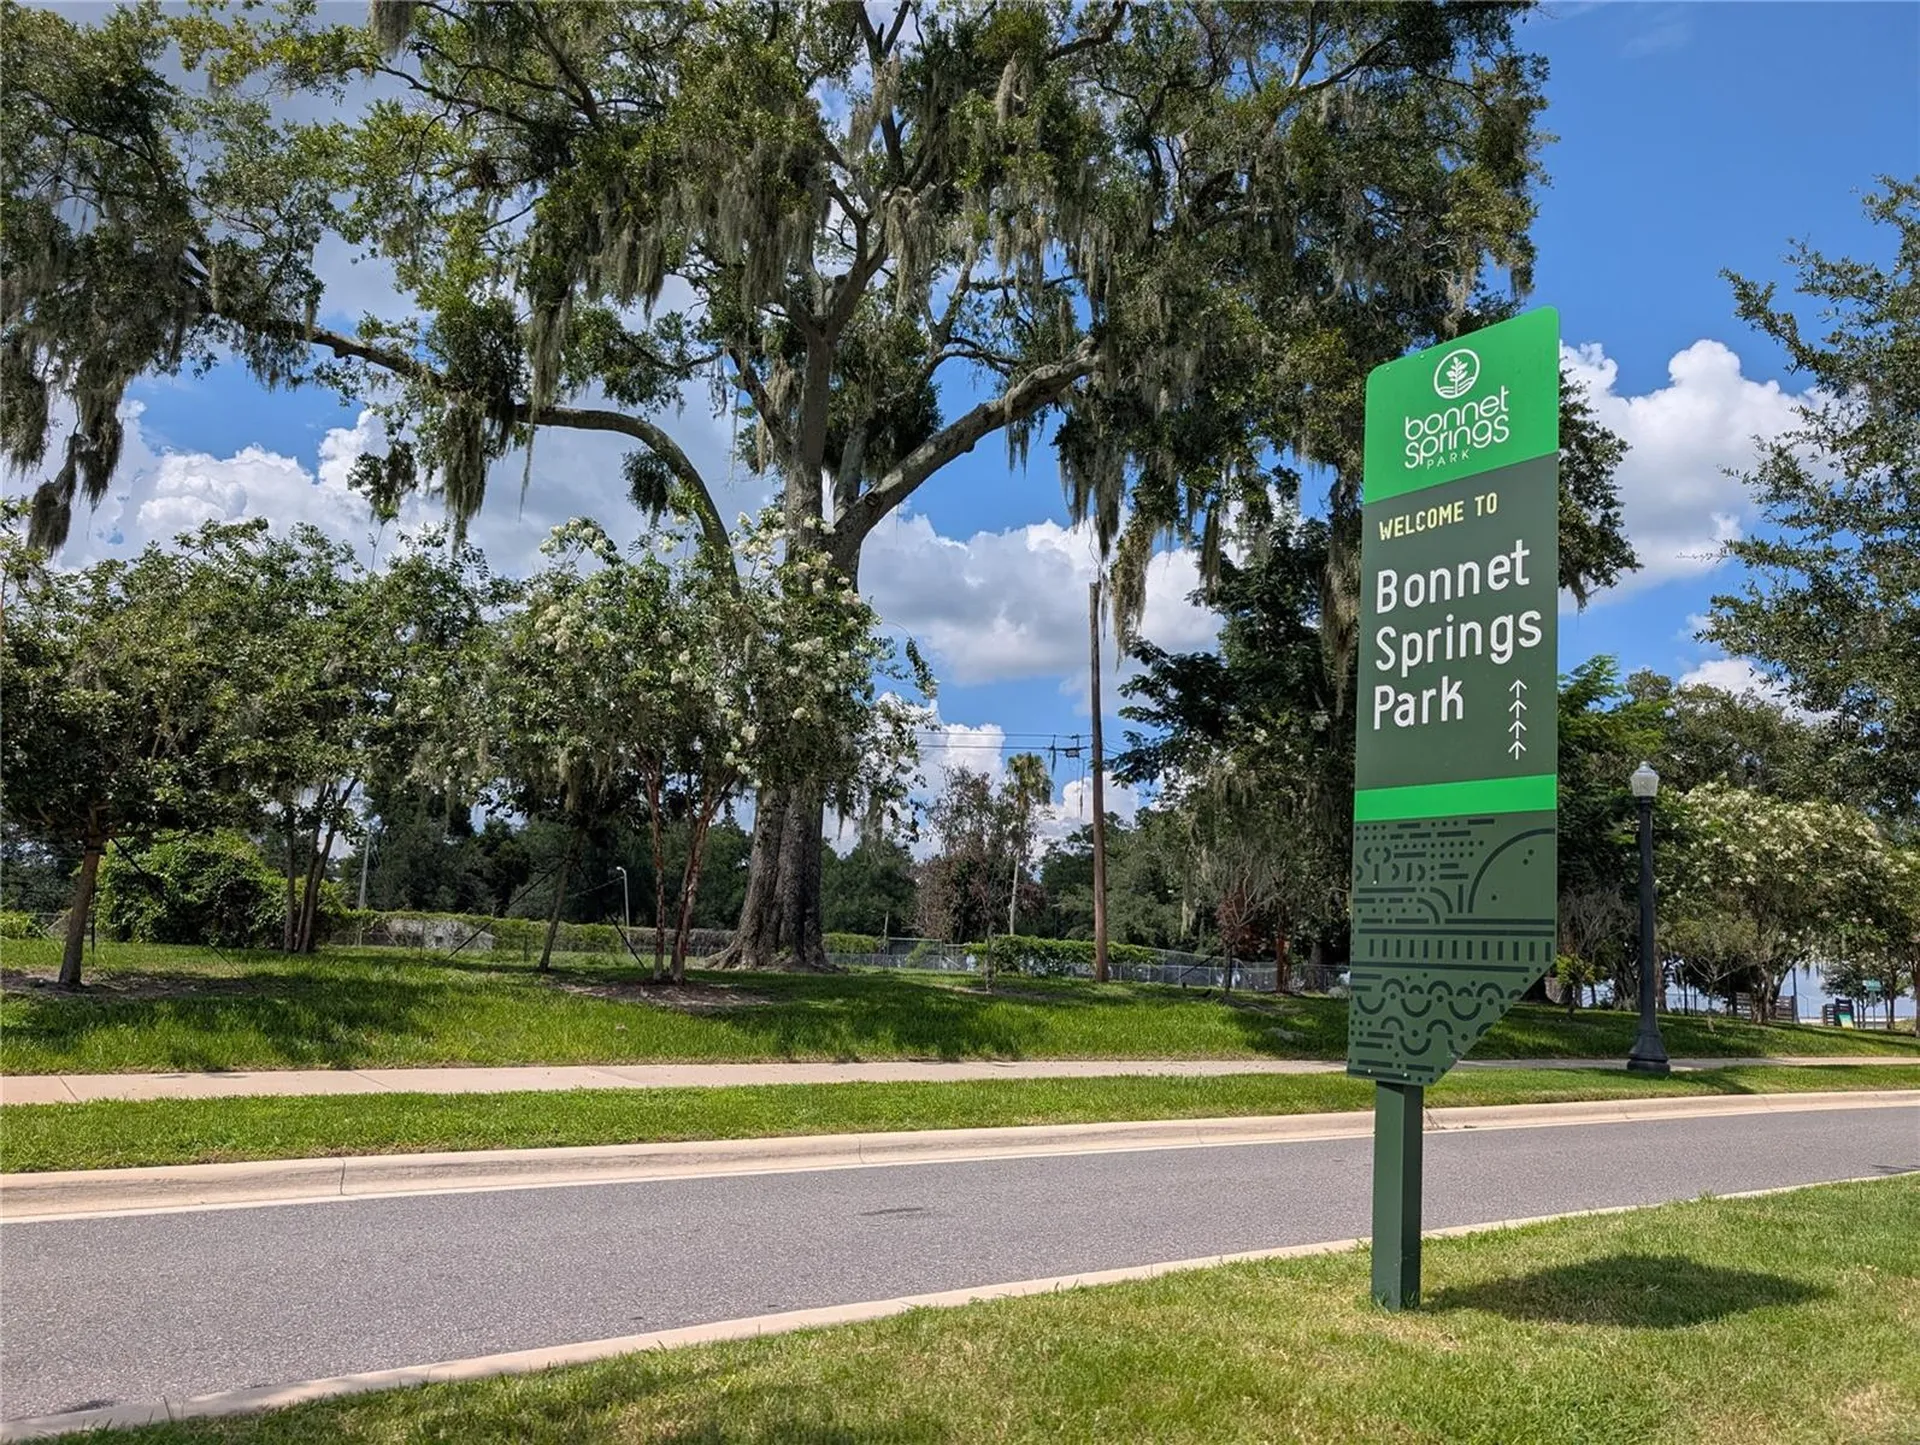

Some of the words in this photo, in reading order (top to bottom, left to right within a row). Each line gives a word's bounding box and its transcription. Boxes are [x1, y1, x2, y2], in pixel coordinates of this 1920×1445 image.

[1405, 385, 1509, 440] bonnet
[1404, 415, 1509, 469] springs
[1427, 449, 1470, 470] PARK
[1378, 500, 1464, 541] WELCOME
[1475, 492, 1497, 517] TO
[1377, 539, 1530, 614] Bonnet
[1375, 610, 1542, 678] Springs
[1374, 675, 1463, 731] Park
